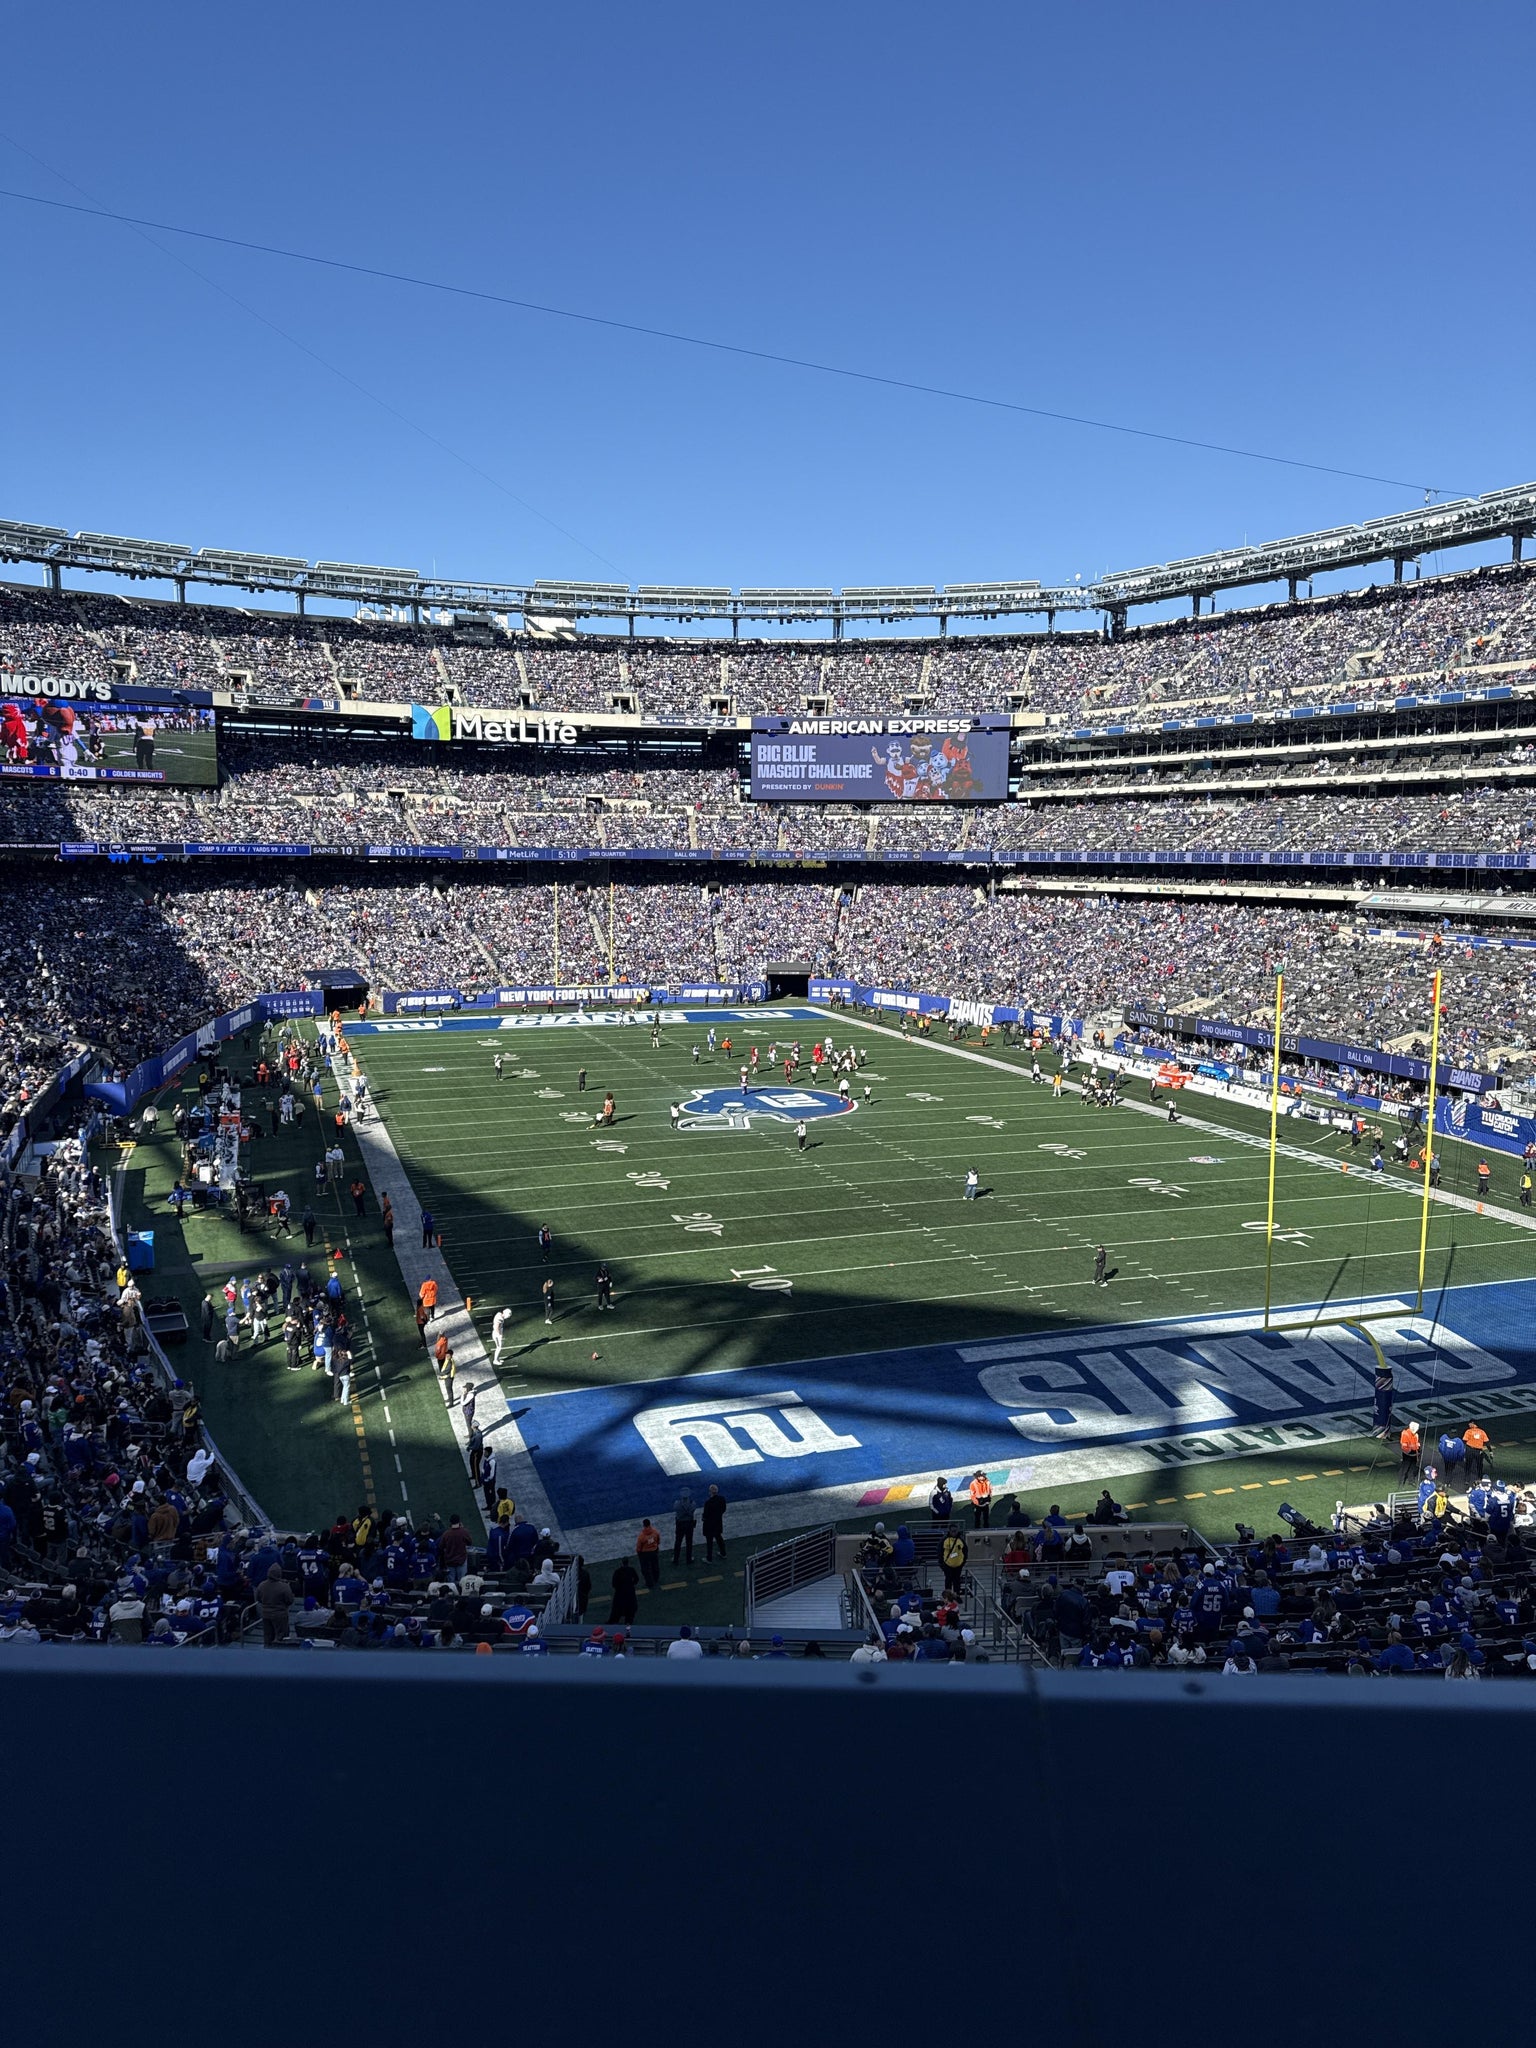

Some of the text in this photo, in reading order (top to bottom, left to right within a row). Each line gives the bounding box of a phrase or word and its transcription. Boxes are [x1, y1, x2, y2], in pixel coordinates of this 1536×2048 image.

[1, 674, 112, 700] MOODY'S
[455, 713, 578, 745] MetLife
[788, 719, 972, 734] AMERICAN EXPRESS
[757, 744, 817, 762] BIG BLUE
[1, 765, 34, 774] MASCOTS
[49, 767, 56, 776] 6
[68, 768, 88, 777] 0:40
[100, 769, 107, 777] 0
[112, 770, 163, 779] GOLDEN KNIGHTS
[757, 764, 873, 779] MASCOT CHALLENGE
[341, 846, 352, 855] 10
[369, 847, 406, 856] GIANTS 10
[464, 850, 477, 858] 25
[509, 850, 539, 858] MetLife
[558, 851, 577, 859] 5:10
[1191, 853, 1223, 863] BIG BLUE
[1229, 853, 1263, 863] BIG BLUE
[1270, 853, 1304, 864] BIG BLUE
[1310, 854, 1346, 865] BIG BLUE
[1389, 854, 1429, 866] BIG BLUE
[1436, 855, 1478, 867] BIG BLUE
[1486, 855, 1530, 868] BIG BLUE
[500, 989, 527, 1002] NEW
[528, 989, 553, 1002] YORK
[555, 988, 605, 1001] FOOTBALL
[950, 1000, 995, 1028] GIANTS
[1129, 1011, 1174, 1029] SAINTS 10
[1201, 1024, 1243, 1039] 2ND QUARTER
[1284, 1037, 1297, 1051] 25
[1347, 1051, 1373, 1065] BALL ON
[1449, 1069, 1483, 1090] GIANTS
[1493, 1121, 1514, 1132] CATCH
[1494, 1114, 1520, 1127] CRUCIAL
[1037, 1142, 1088, 1160] 30
[626, 1170, 671, 1191] 30
[1127, 1177, 1190, 1199] 20
[670, 1211, 724, 1237] 20
[1240, 1220, 1315, 1248] 10
[729, 1264, 794, 1298] 10
[977, 1315, 1519, 1444] GIANTS
[1141, 1420, 1328, 1465] CATCH
[1500, 1505, 1508, 1518] 5
[387, 1557, 395, 1569] 6
[1202, 1594, 1223, 1612] 56
